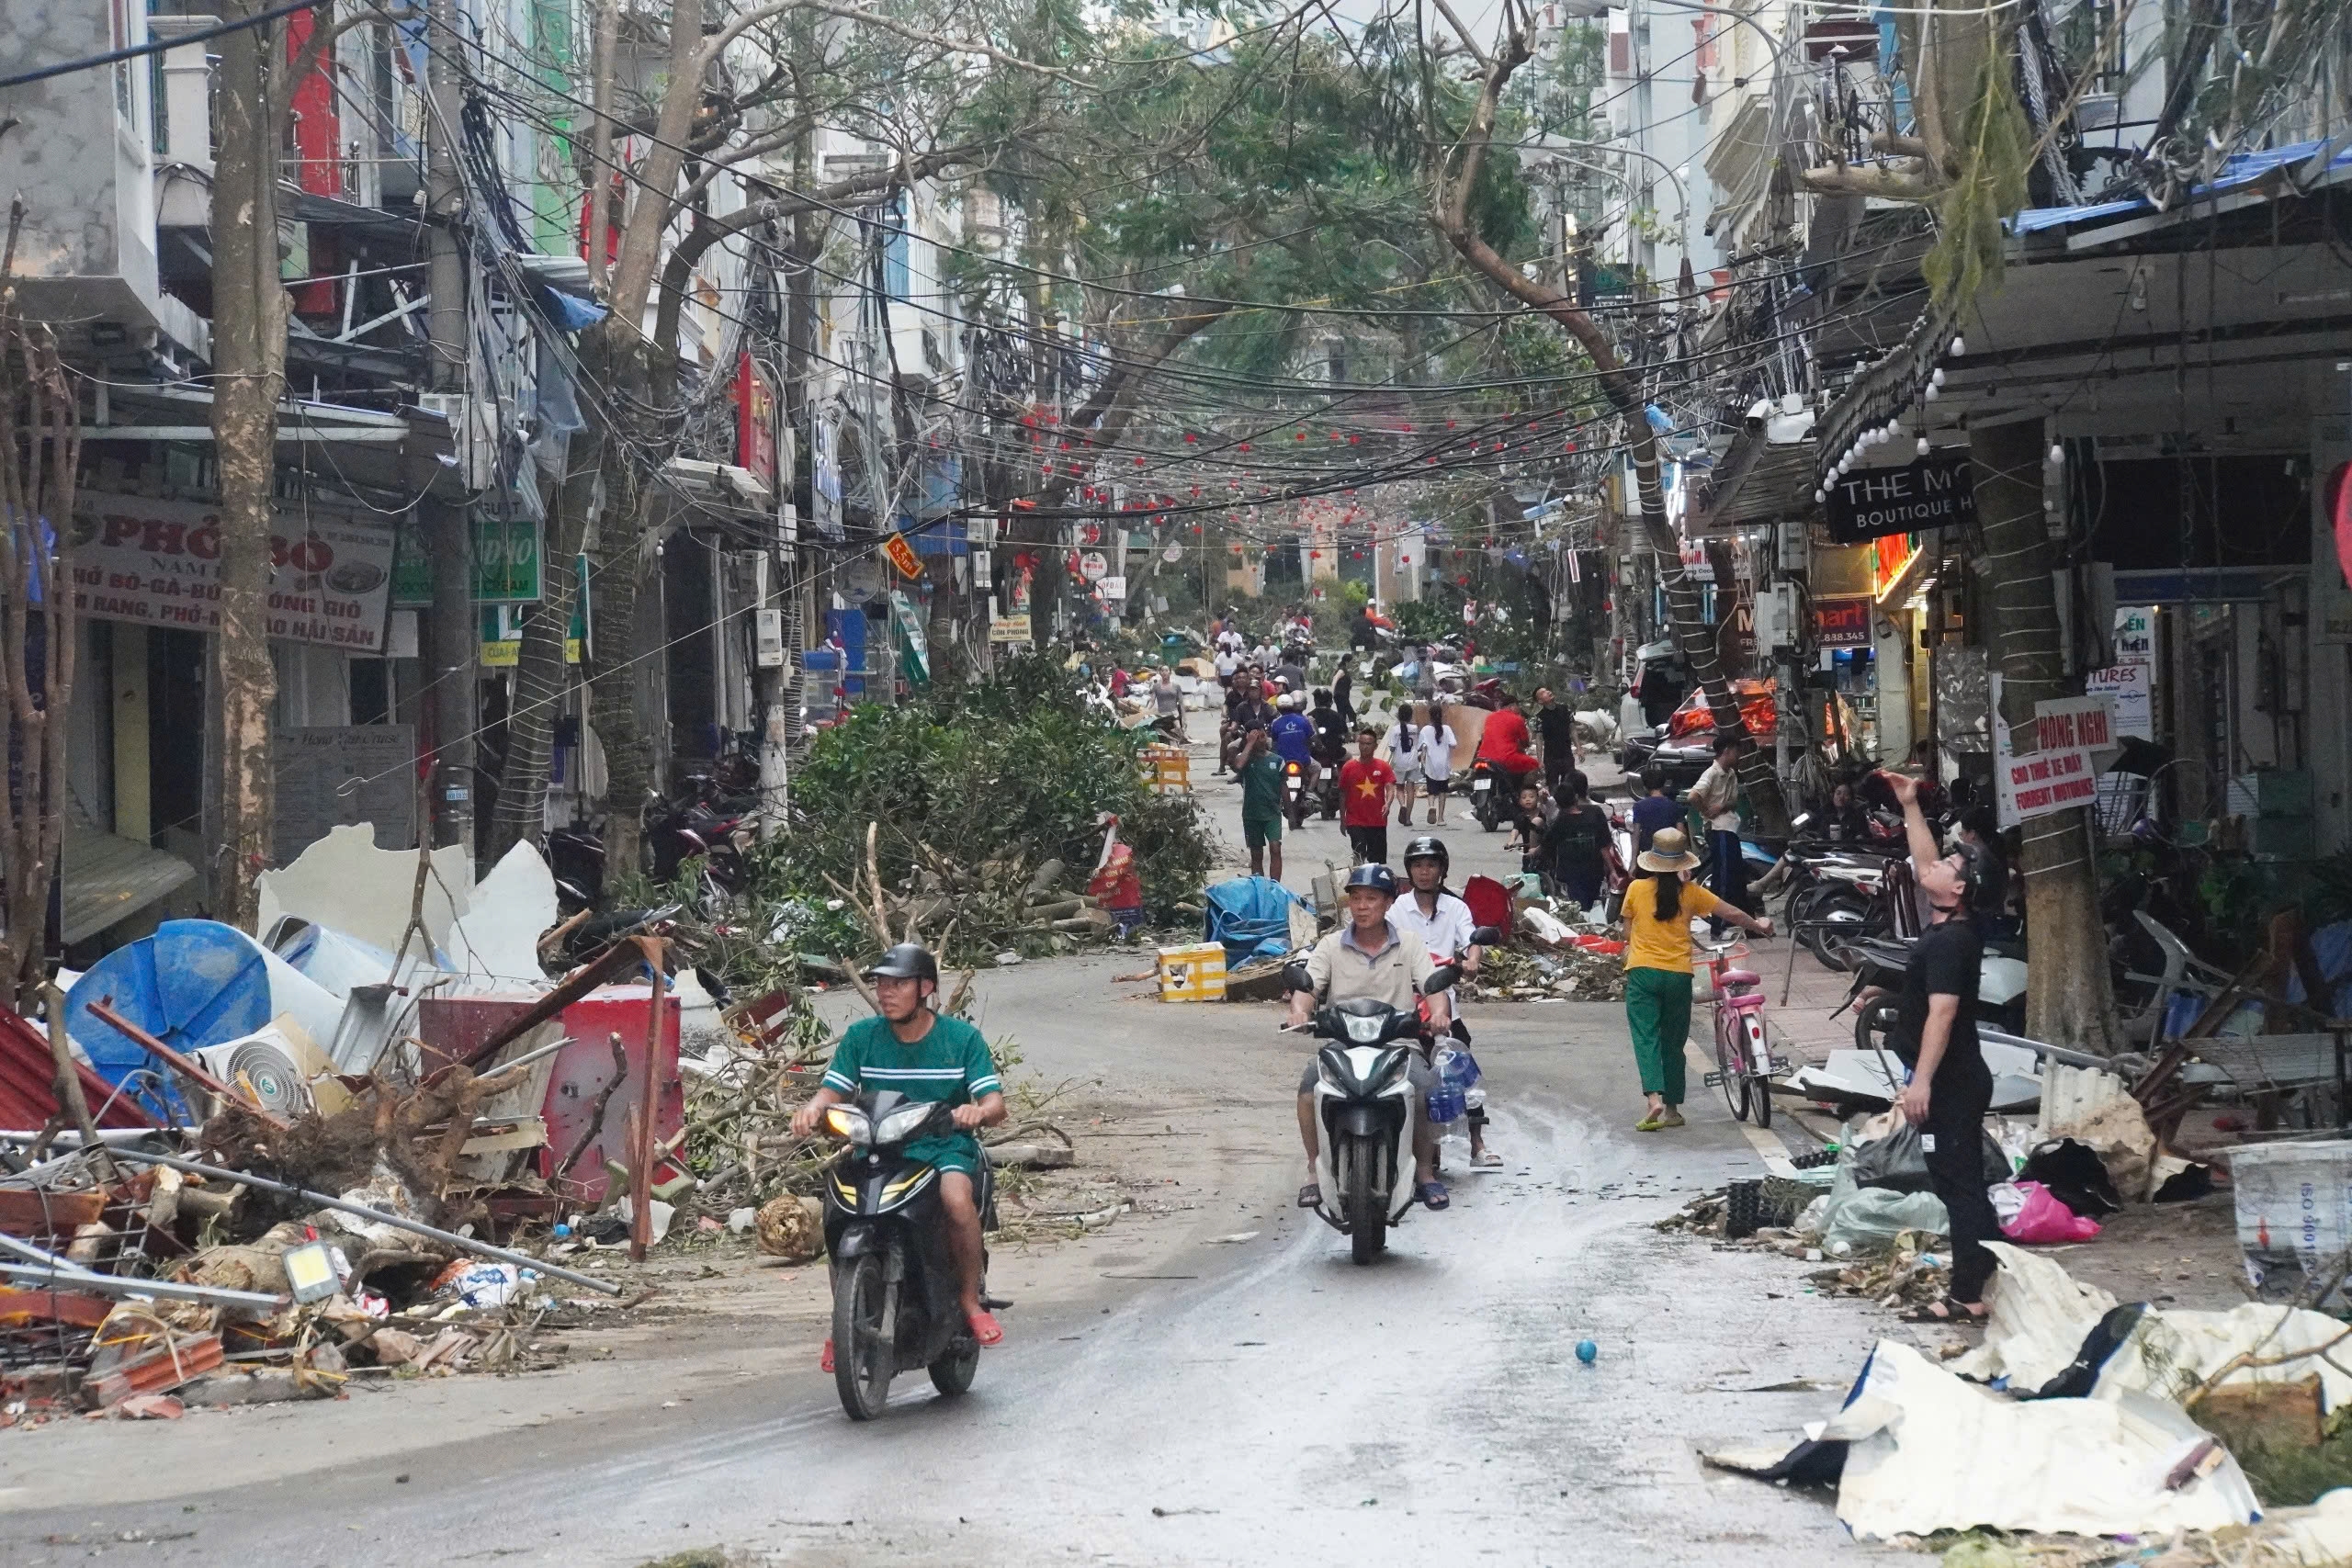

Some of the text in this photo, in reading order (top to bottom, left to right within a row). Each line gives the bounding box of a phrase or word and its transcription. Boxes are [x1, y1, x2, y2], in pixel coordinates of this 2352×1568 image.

[1840, 471, 1914, 505] THE
[1856, 499, 1952, 529] BOUTIQUE
[2301, 1182, 2314, 1211] ISO
